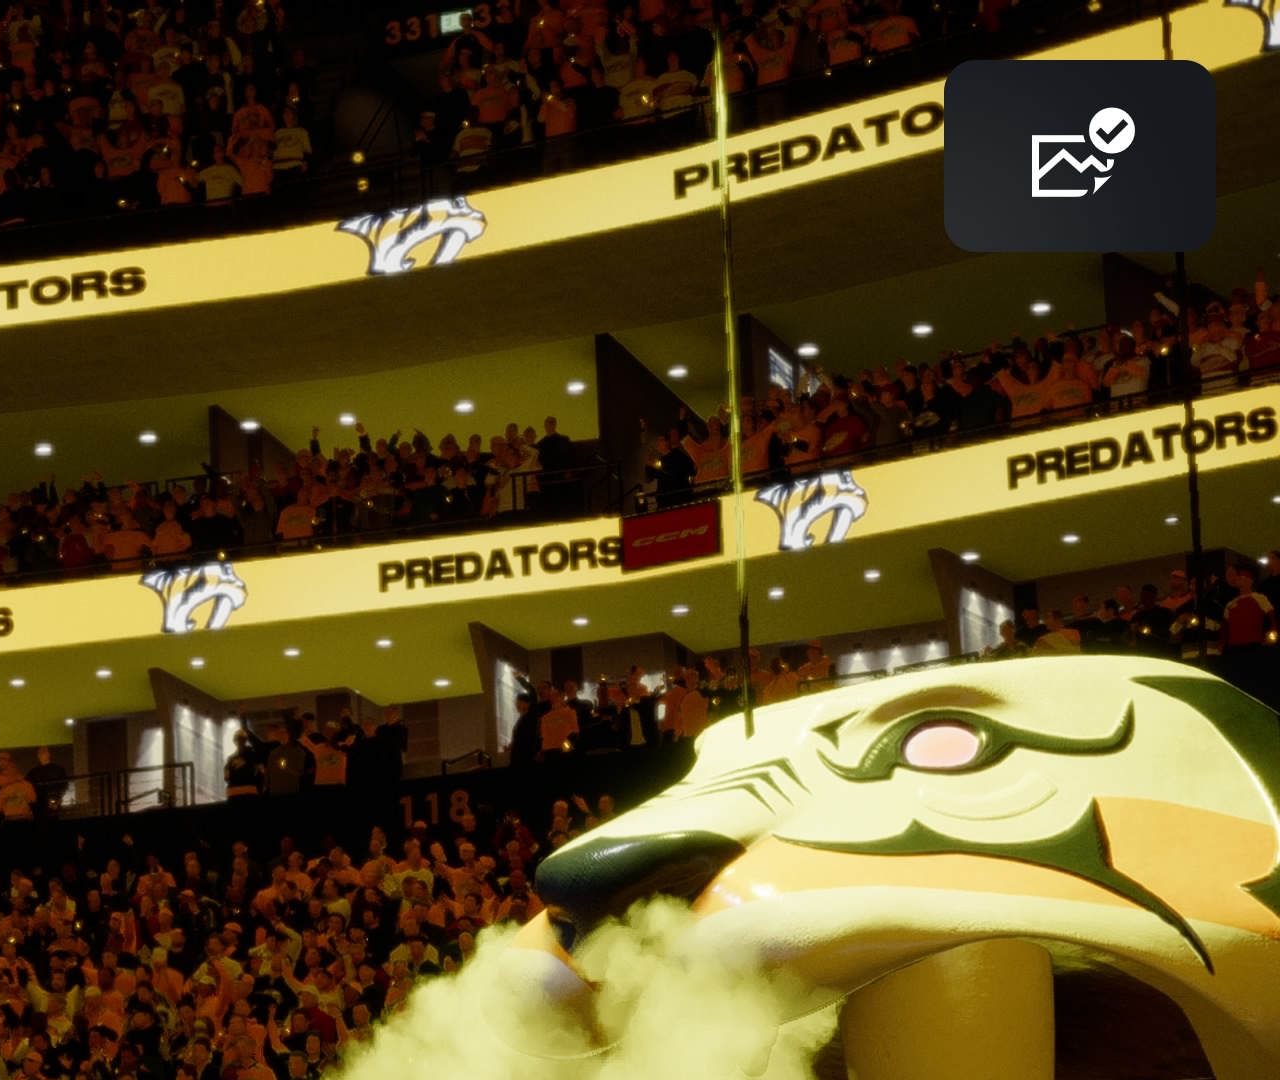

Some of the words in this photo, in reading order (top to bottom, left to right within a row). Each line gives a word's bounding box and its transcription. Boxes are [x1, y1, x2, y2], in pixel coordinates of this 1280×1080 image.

[384, 12, 439, 46] 331
[1007, 406, 1279, 490] PREDATORS
[632, 524, 710, 549] CCM
[378, 536, 623, 593] PREDATORS
[398, 789, 472, 830] 118
